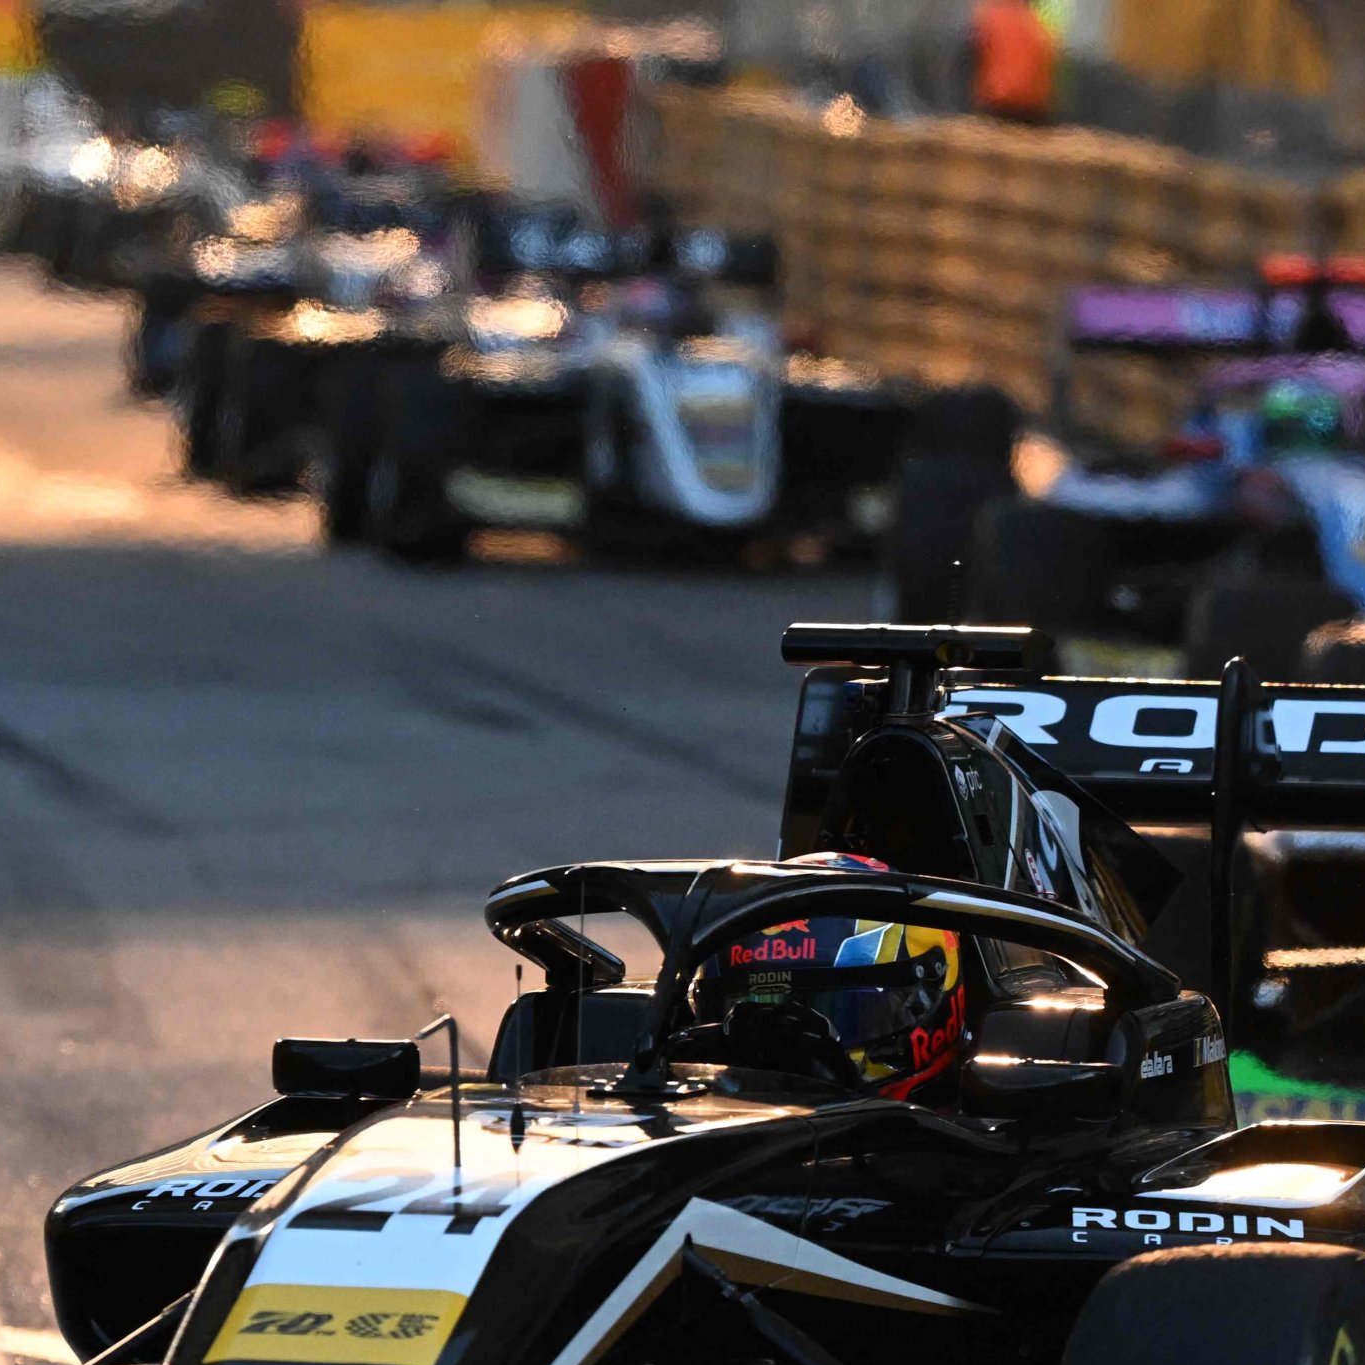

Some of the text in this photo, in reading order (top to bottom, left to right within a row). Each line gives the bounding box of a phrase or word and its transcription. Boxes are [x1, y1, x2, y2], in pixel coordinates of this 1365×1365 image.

[730, 937, 816, 967] Red Bull
[748, 970, 792, 985] RODIN
[147, 1179, 281, 1199] ROD
[285, 1166, 528, 1236] 24
[1072, 1206, 1305, 1239] RODIN
[1072, 1230, 1245, 1247] CAR
